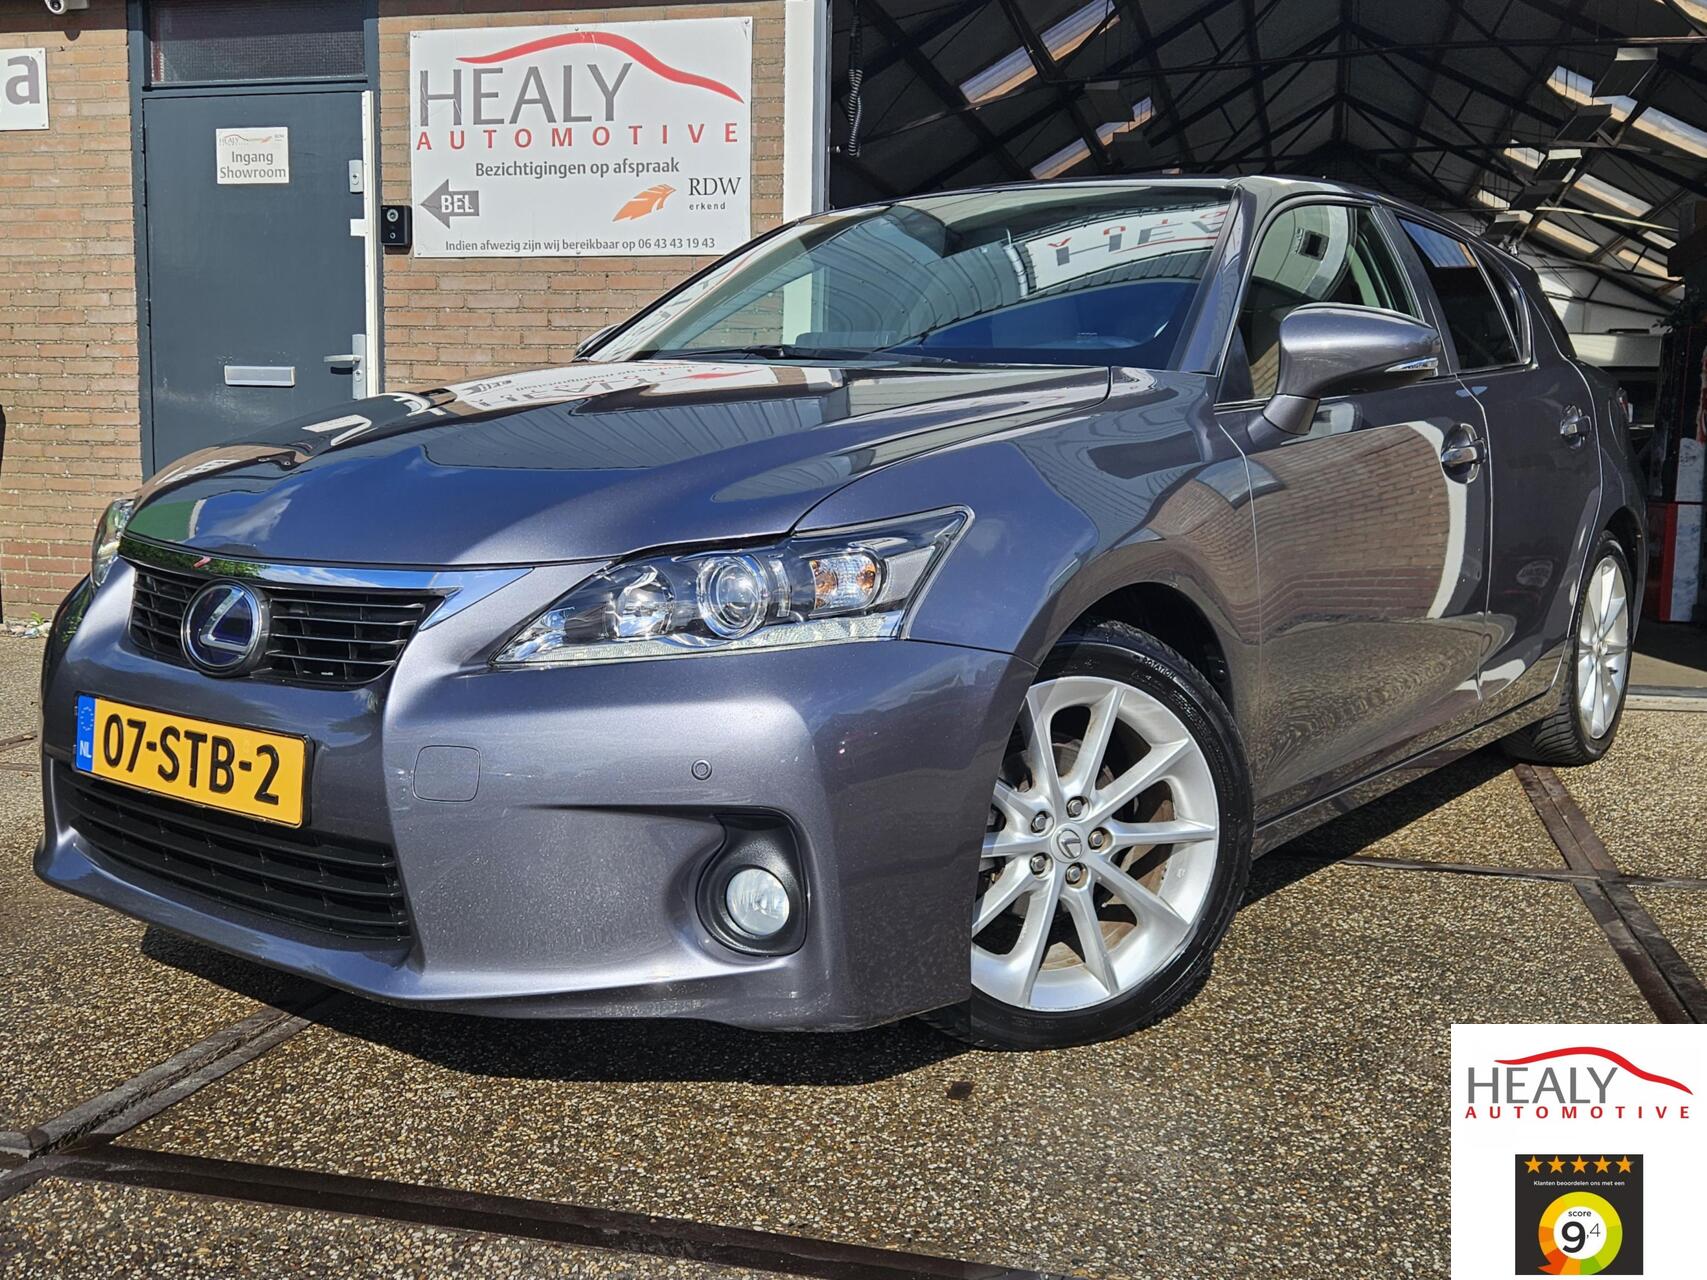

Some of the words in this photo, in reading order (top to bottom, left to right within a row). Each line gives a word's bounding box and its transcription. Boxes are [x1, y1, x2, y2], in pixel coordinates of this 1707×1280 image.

[419, 62, 633, 127] HEALY
[416, 122, 739, 151] AUTOMOTIVE
[231, 151, 273, 166] Ingang
[475, 161, 586, 179] Bezichtigingen
[590, 163, 610, 178] op
[613, 157, 680, 177] afspraak
[220, 166, 287, 179] Showroom
[688, 176, 741, 196] RDW
[440, 194, 475, 214] BEL
[689, 201, 727, 211] erkend
[445, 240, 478, 251] Indien
[480, 239, 521, 252] afwezig
[522, 239, 542, 252] zijn
[543, 239, 560, 252] wij
[562, 238, 620, 250] bereikbaar
[621, 241, 636, 252] op
[638, 238, 652, 249] 06
[654, 238, 667, 249] 43
[669, 238, 683, 249] 43
[686, 238, 699, 248] 19
[702, 237, 715, 248] 43
[79, 740, 92, 759] NL
[103, 713, 280, 805] 07-STB-2
